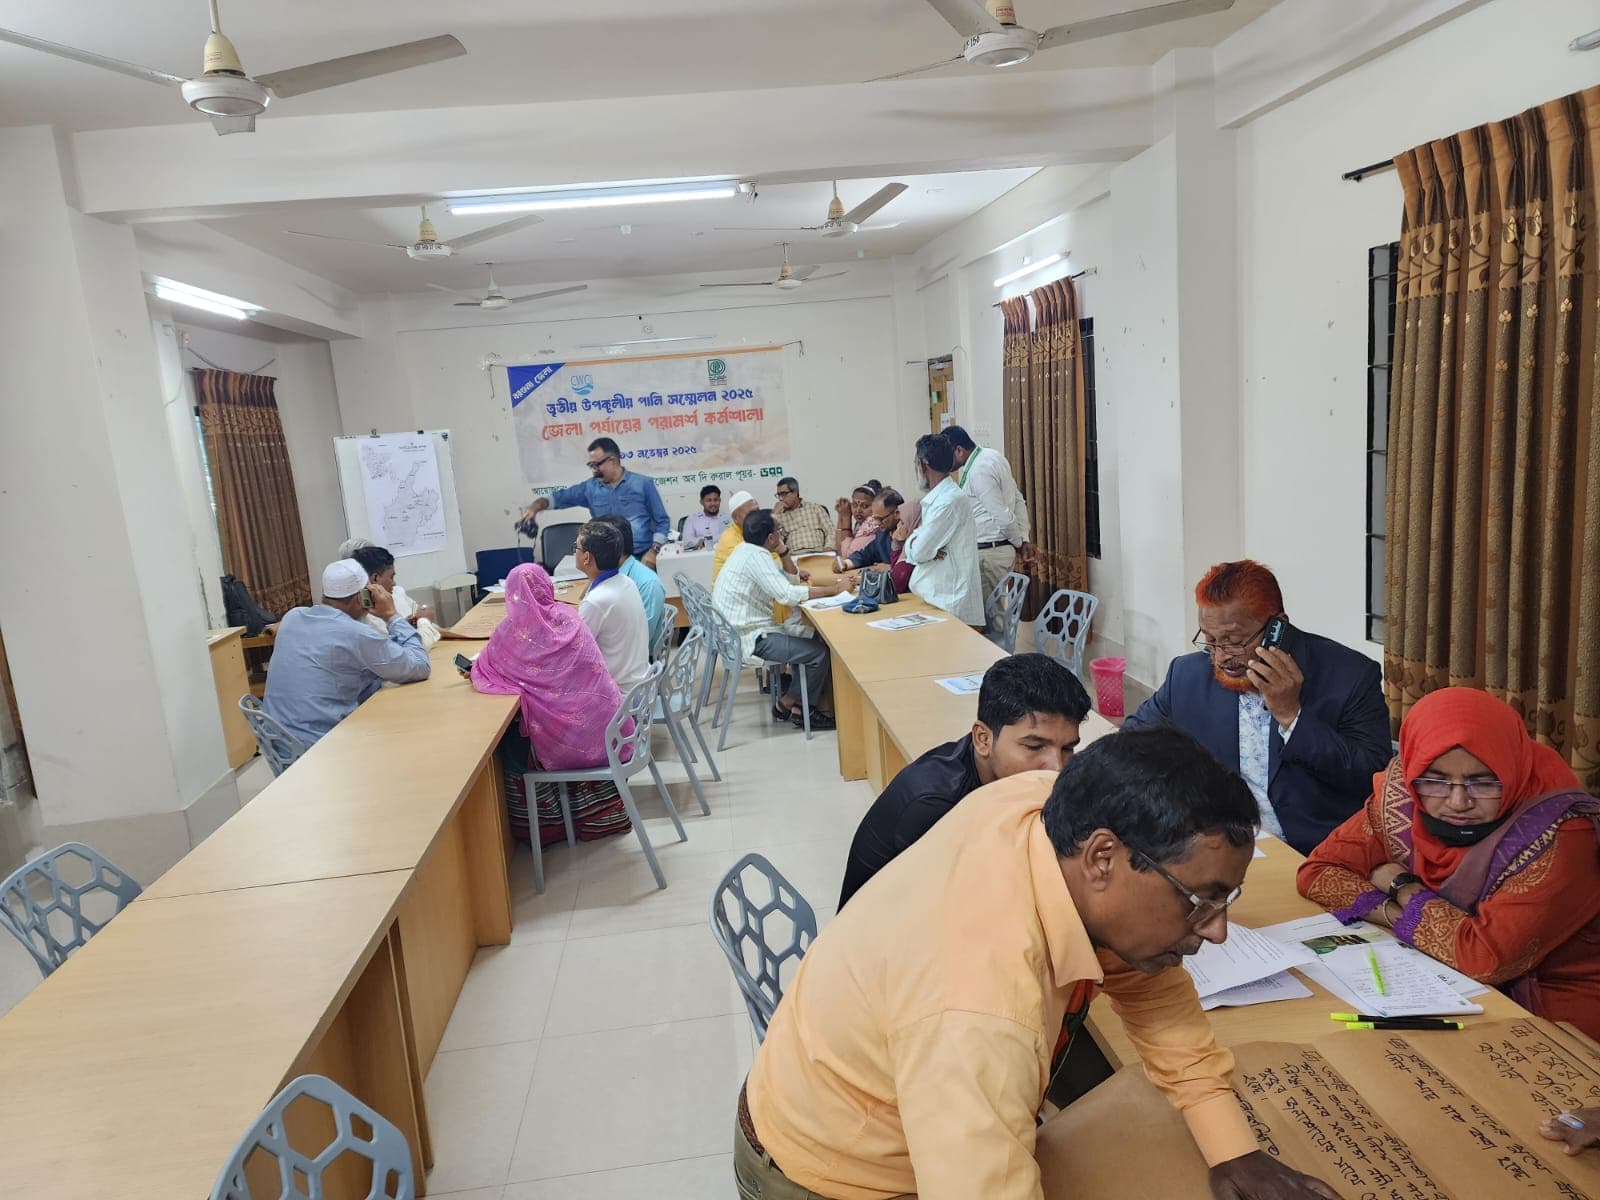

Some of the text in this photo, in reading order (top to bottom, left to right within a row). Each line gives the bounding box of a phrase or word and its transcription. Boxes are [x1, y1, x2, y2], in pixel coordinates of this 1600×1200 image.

[546, 388, 753, 417] তৃতীয় উপকূলীয় পানি সম্মেলন ২০২৫
[542, 407, 764, 440] জেলা পর্যায়ের পরামর্শ কর্মশালা
[637, 447, 669, 460] নভেম্বর
[672, 446, 697, 455] ২০২৫
[682, 473, 696, 483] অব
[698, 471, 707, 482] দি
[710, 471, 732, 481] রুরাল
